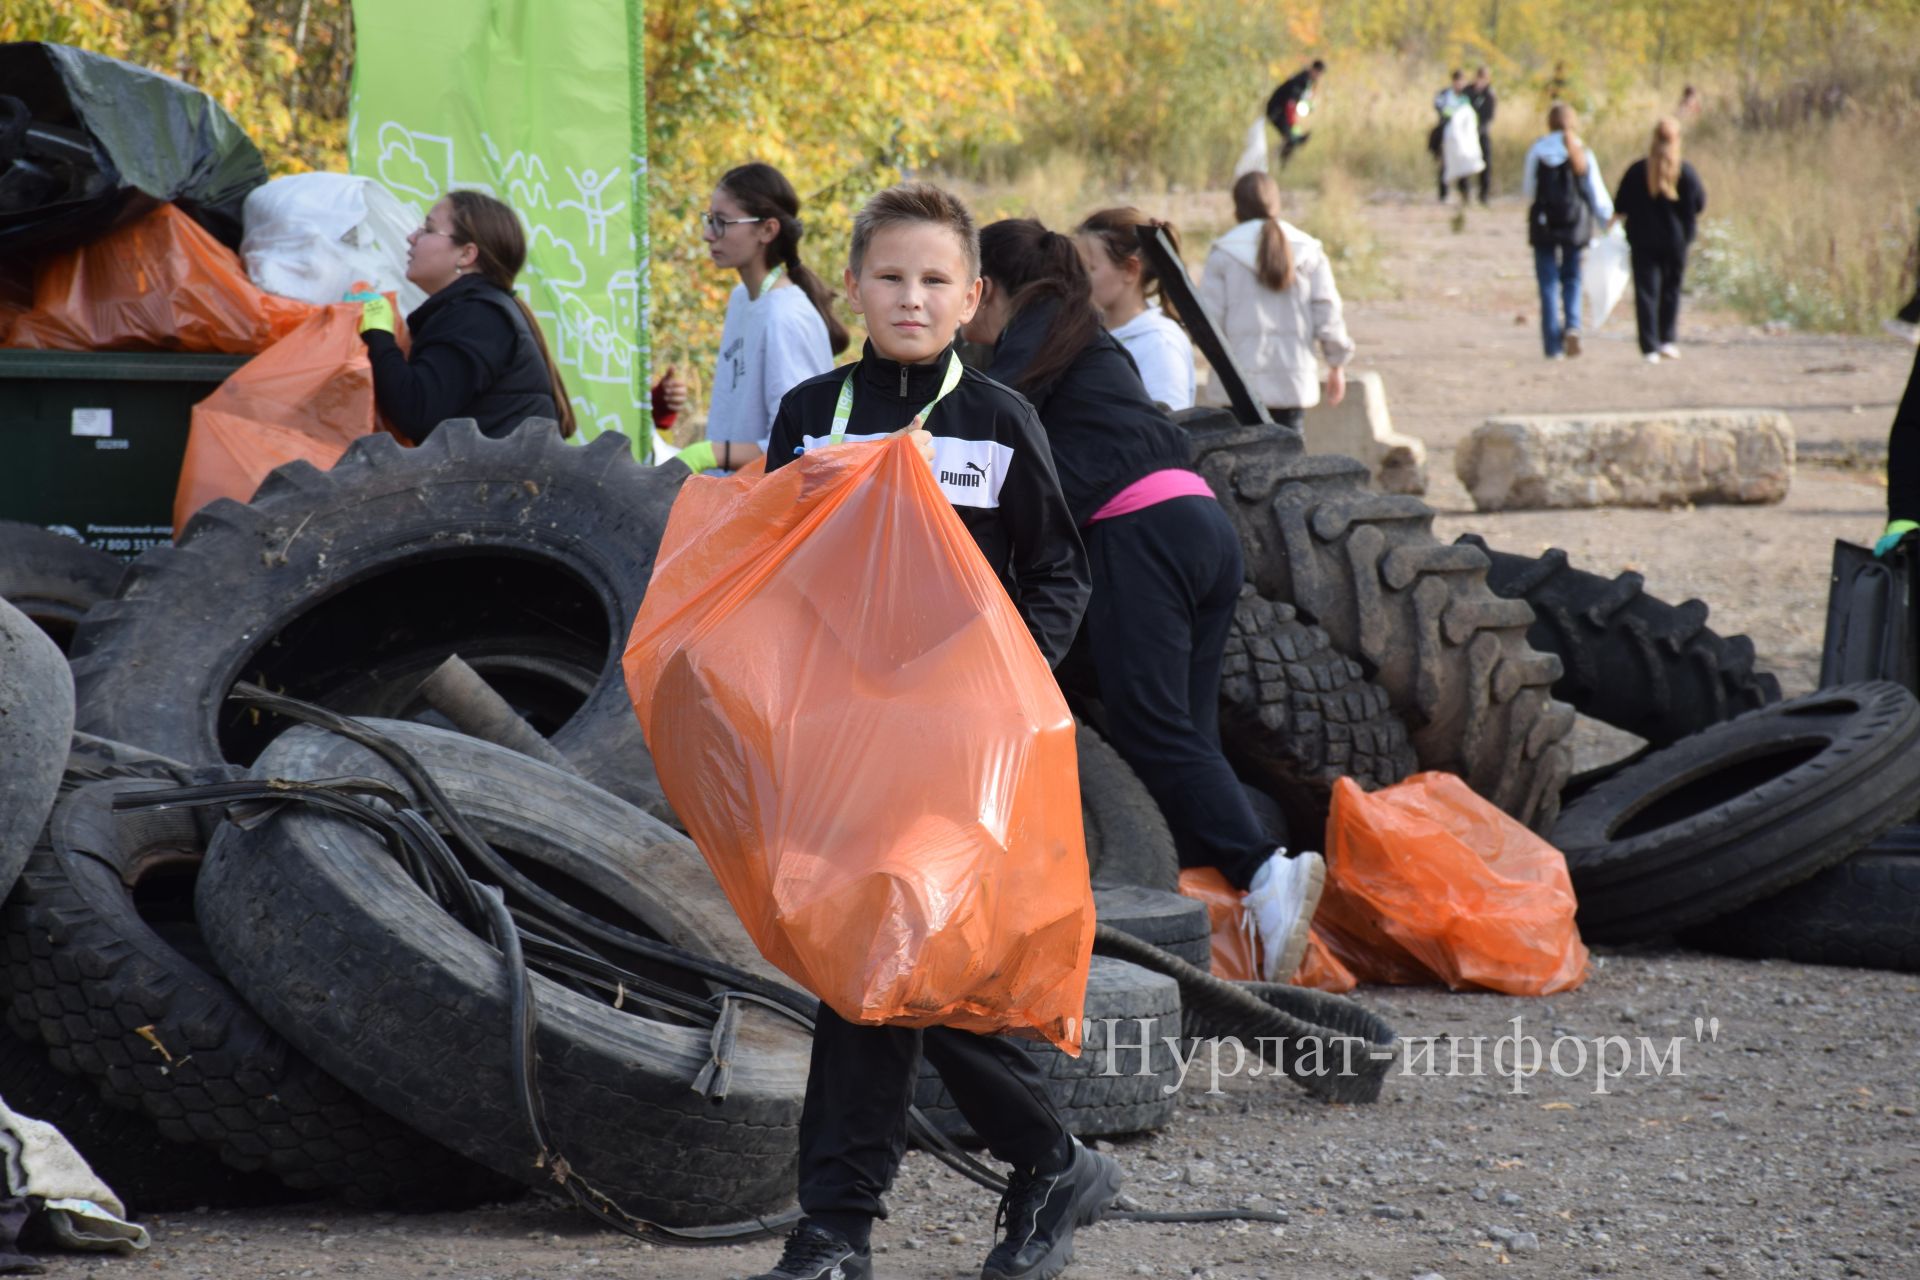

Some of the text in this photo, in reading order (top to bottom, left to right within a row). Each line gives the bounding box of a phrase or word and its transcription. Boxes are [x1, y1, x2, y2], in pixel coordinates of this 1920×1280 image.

[940, 470, 980, 488] PUMA
[87, 525, 152, 533] Региональный
[108, 539, 131, 550] 800
